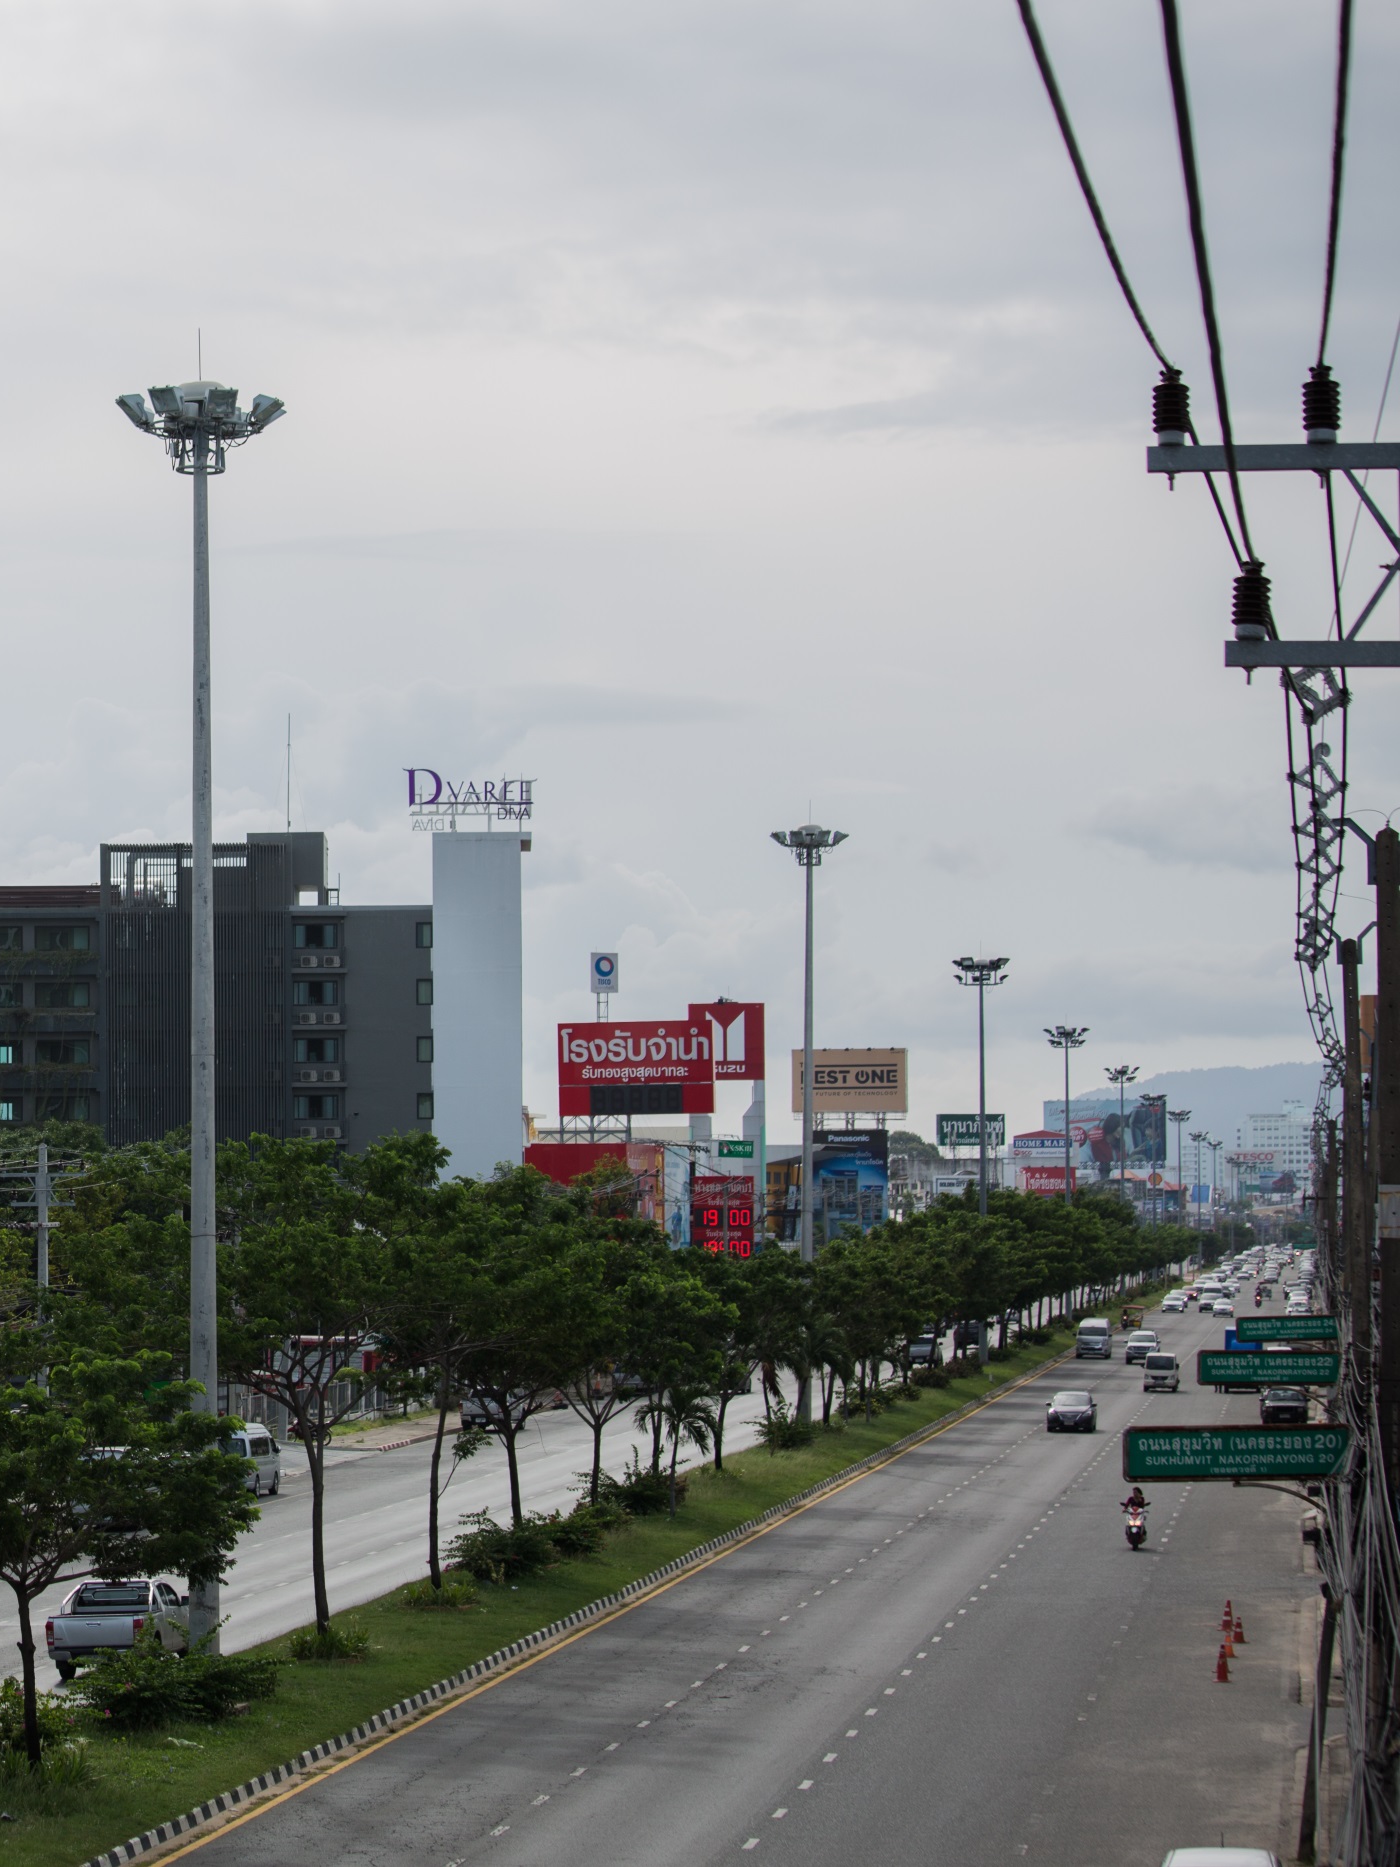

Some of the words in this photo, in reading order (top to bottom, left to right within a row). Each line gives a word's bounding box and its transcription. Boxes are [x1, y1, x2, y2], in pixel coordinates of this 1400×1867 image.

[498, 807, 531, 820] DIVA
[597, 978, 612, 986] TISCO
[560, 1028, 709, 1063] โรงรับจำนำ
[582, 1065, 689, 1082] รับทองสูงสุดบาทละ
[714, 1064, 746, 1074] UZU
[801, 1070, 850, 1085] EST
[855, 1069, 898, 1084] ONE
[827, 1134, 870, 1142] Panasonic
[1015, 1139, 1043, 1148] HOME
[1044, 1139, 1067, 1148] MAR
[1234, 1152, 1274, 1161] TESCO
[1207, 1355, 1260, 1371] ถนนสุขุมวิท
[1257, 1368, 1318, 1376] NAKORNRAYONG
[1138, 1432, 1223, 1455] ถนนสุขุมวิท
[1145, 1455, 1212, 1465] SUKHUMVIT
[1219, 1454, 1314, 1465] NAKORNRAYONG
[1319, 1453, 1335, 1463] 20
